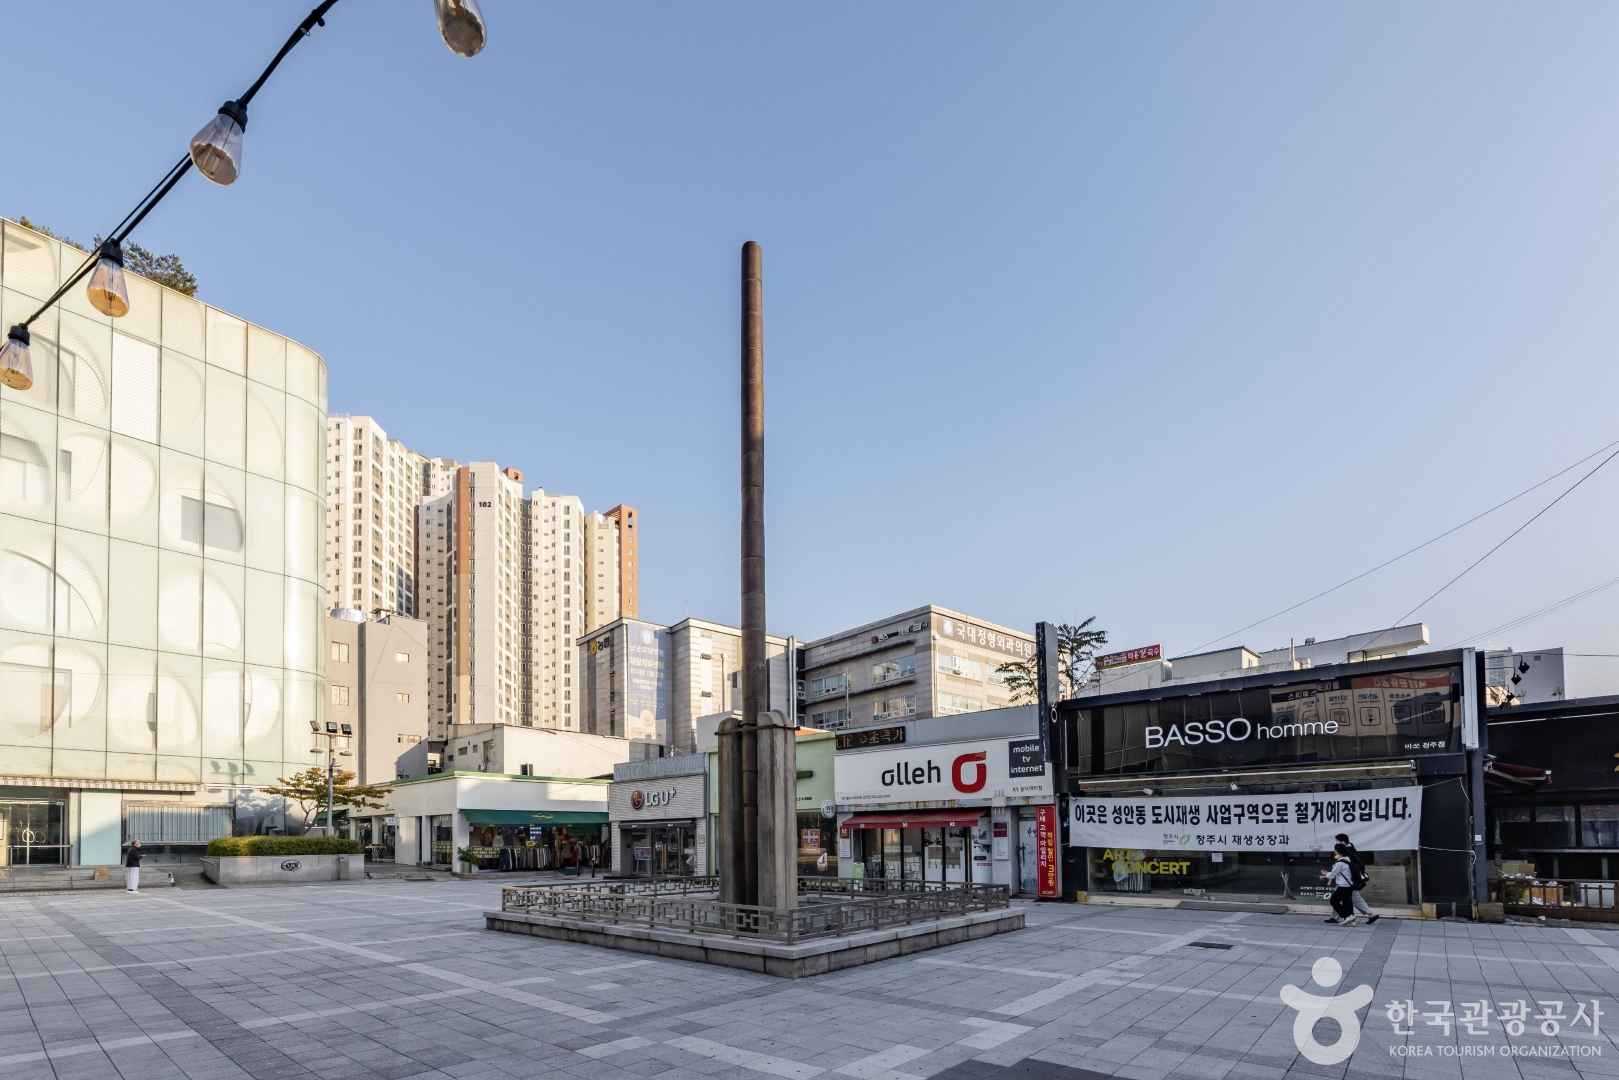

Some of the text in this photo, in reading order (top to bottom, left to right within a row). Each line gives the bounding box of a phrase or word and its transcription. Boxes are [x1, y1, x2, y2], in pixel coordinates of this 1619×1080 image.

[1145, 718, 1339, 749] BASSO homme
[1013, 744, 1040, 753] mobile
[1022, 755, 1031, 763] tv
[881, 760, 941, 787] olleh
[1010, 765, 1042, 774] internet
[1074, 797, 1412, 825] 이곳은 성안동 도시재생 사업구역으로 철거예정입니다.
[1196, 834, 1290, 846] 청주시 재생성장과
